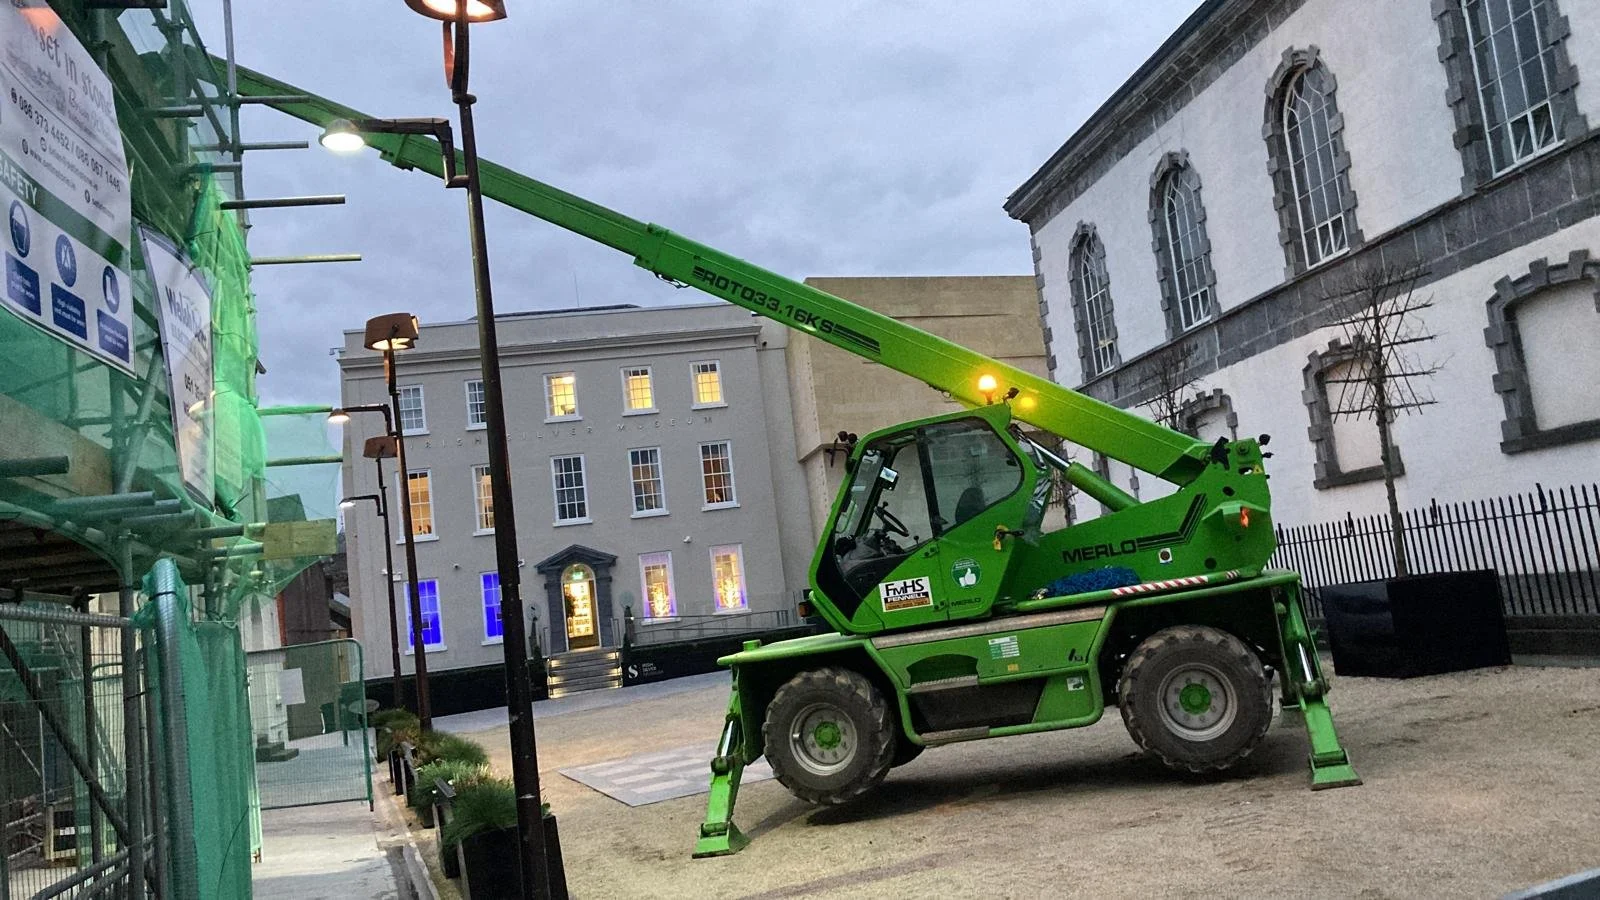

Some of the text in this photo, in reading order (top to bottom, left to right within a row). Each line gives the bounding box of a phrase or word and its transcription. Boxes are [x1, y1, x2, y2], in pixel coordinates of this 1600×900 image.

[39, 26, 61, 68] set
[64, 52, 78, 86] in
[19, 95, 33, 119] 086
[34, 110, 49, 134] 373
[51, 126, 70, 151] 4452
[91, 158, 104, 177] 067
[409, 416, 713, 450] IRISH SILVER MUSEUM
[1062, 539, 1137, 564] MERLO
[887, 592, 926, 603] FENNELL
